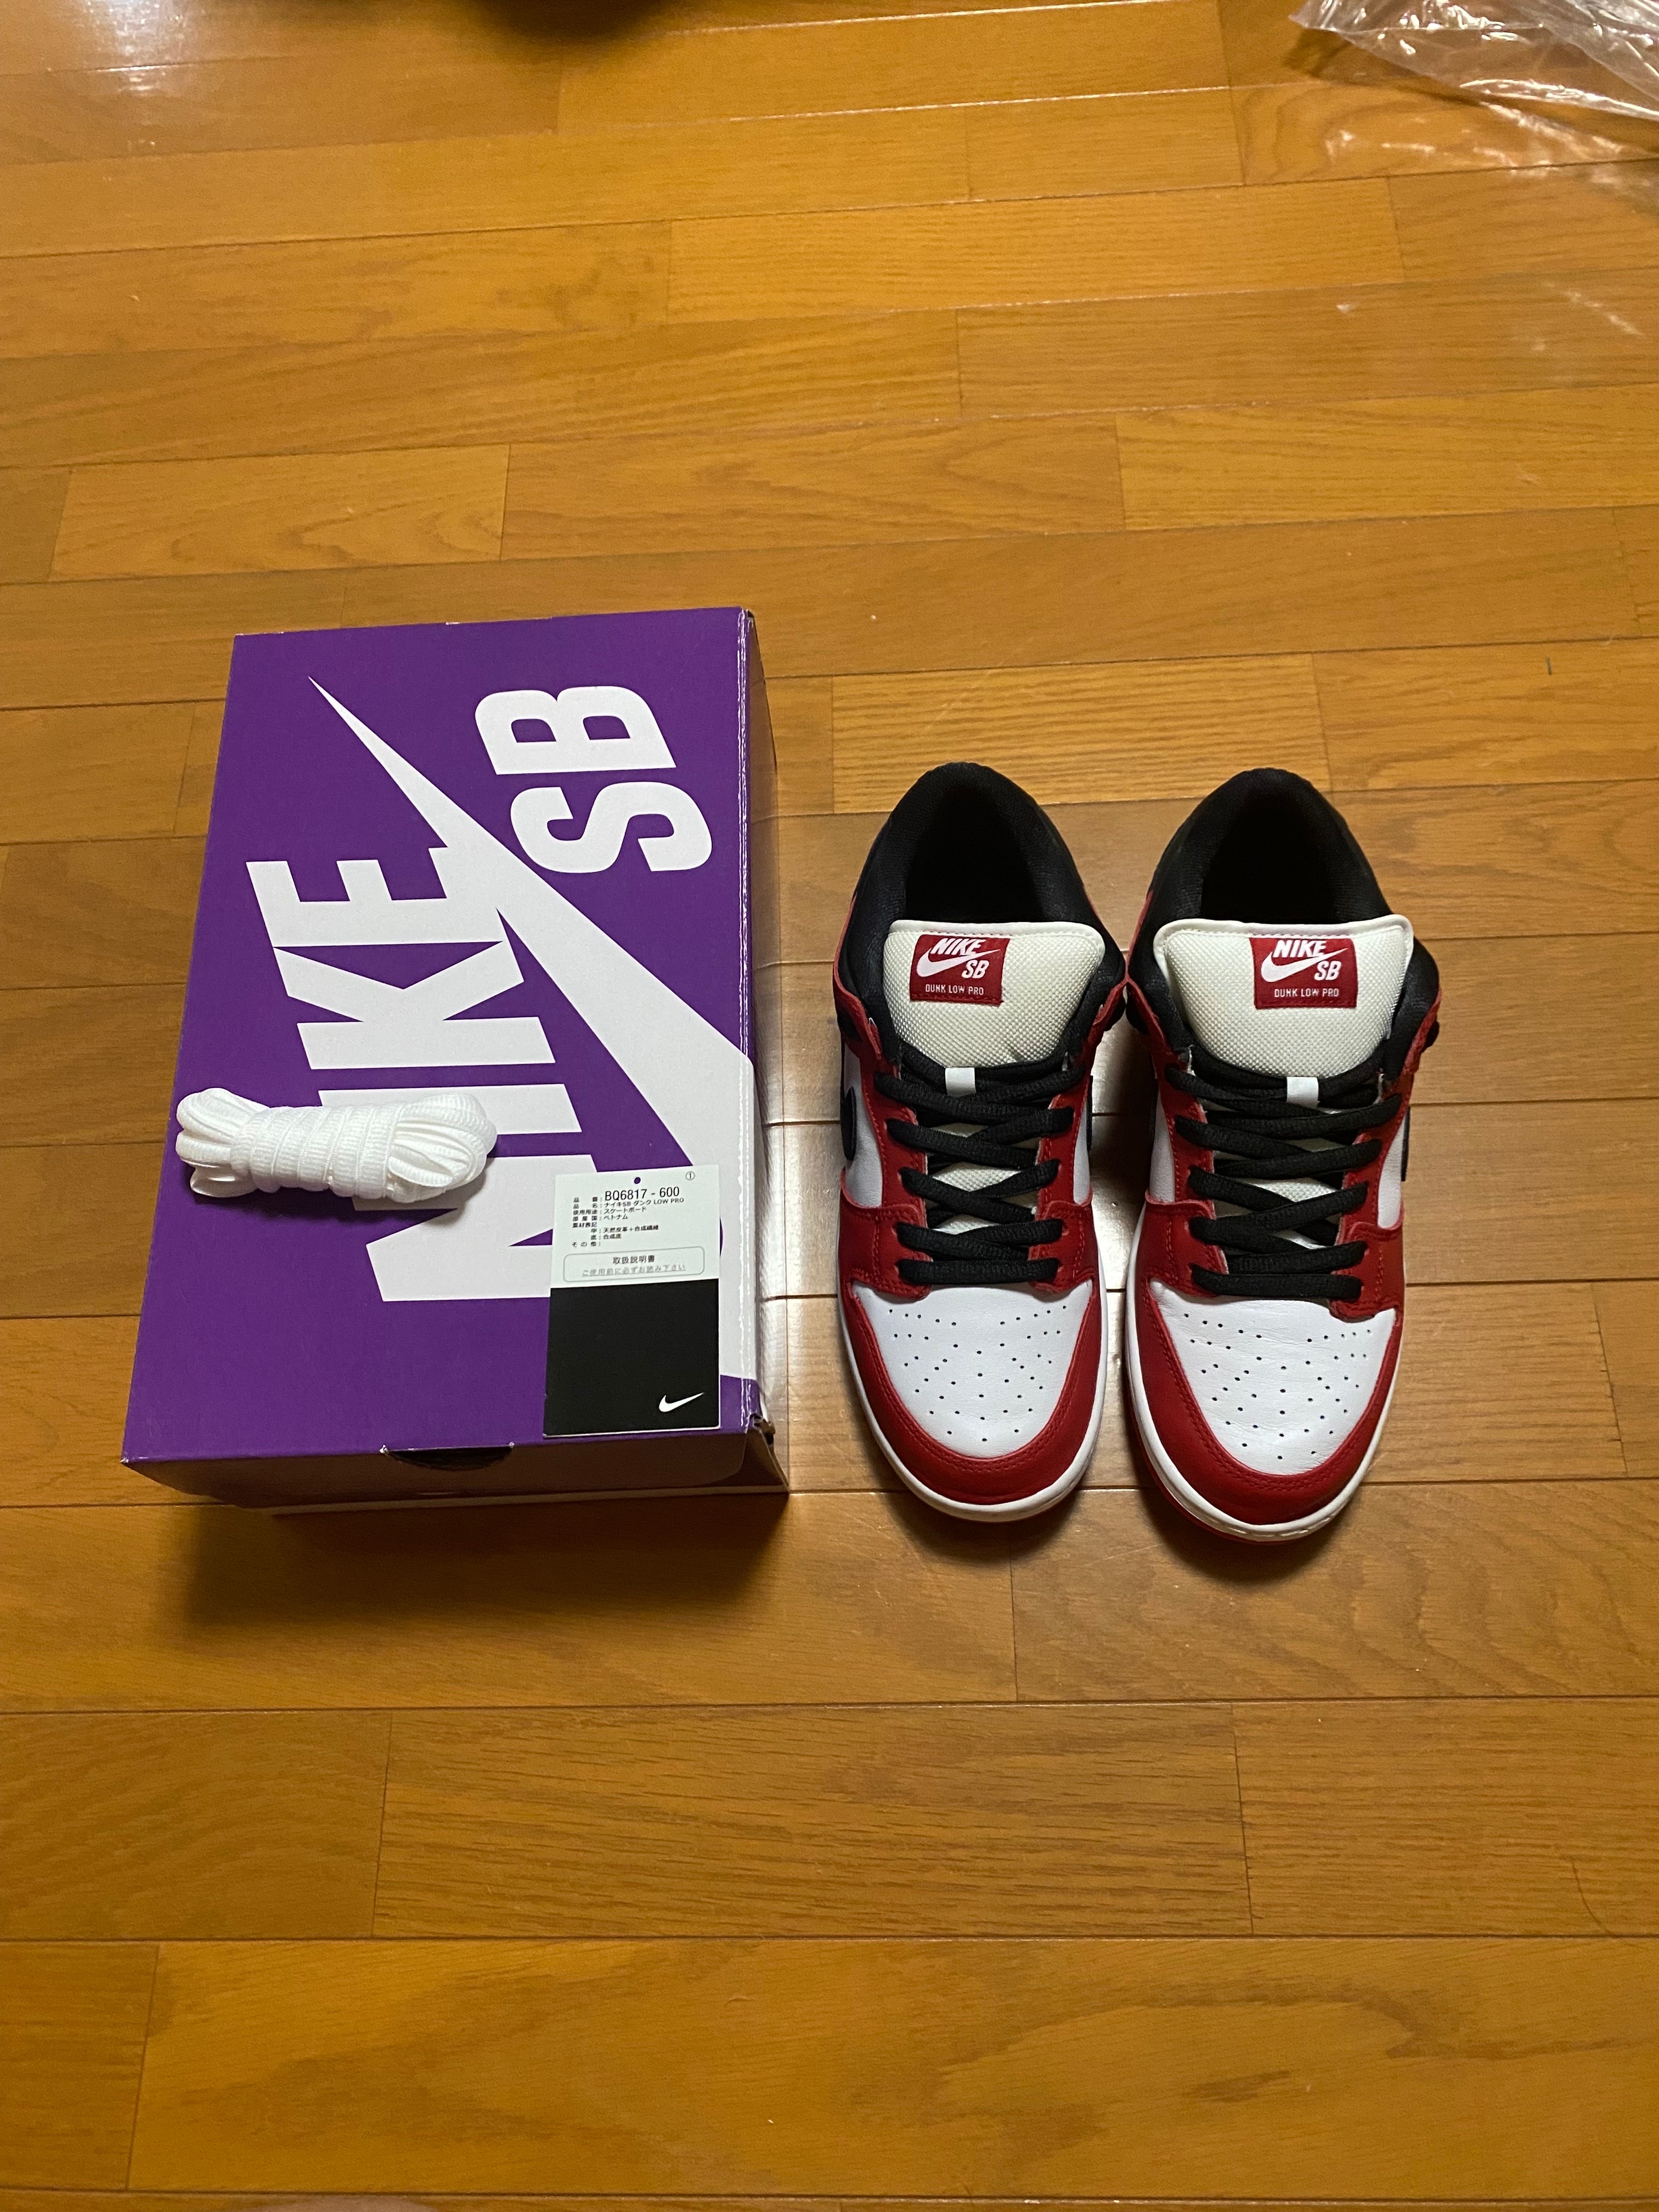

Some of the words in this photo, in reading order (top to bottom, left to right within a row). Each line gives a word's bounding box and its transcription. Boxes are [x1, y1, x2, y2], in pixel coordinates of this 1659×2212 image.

[475, 686, 712, 873] SB
[930, 938, 986, 956] NIKE
[1272, 939, 1327, 958] NIKE
[961, 960, 990, 979] SB
[1314, 960, 1342, 980] SB
[925, 984, 946, 994] DUNK
[948, 984, 966, 994] LOW
[968, 986, 984, 995] PRO
[1274, 988, 1298, 998] DUNK
[1300, 988, 1319, 997] LOW
[1322, 988, 1340, 997] PRO
[605, 1188, 647, 1201] BQ6817
[659, 1186, 680, 1198] 600
[613, 1255, 655, 1265] 取扱説明書
